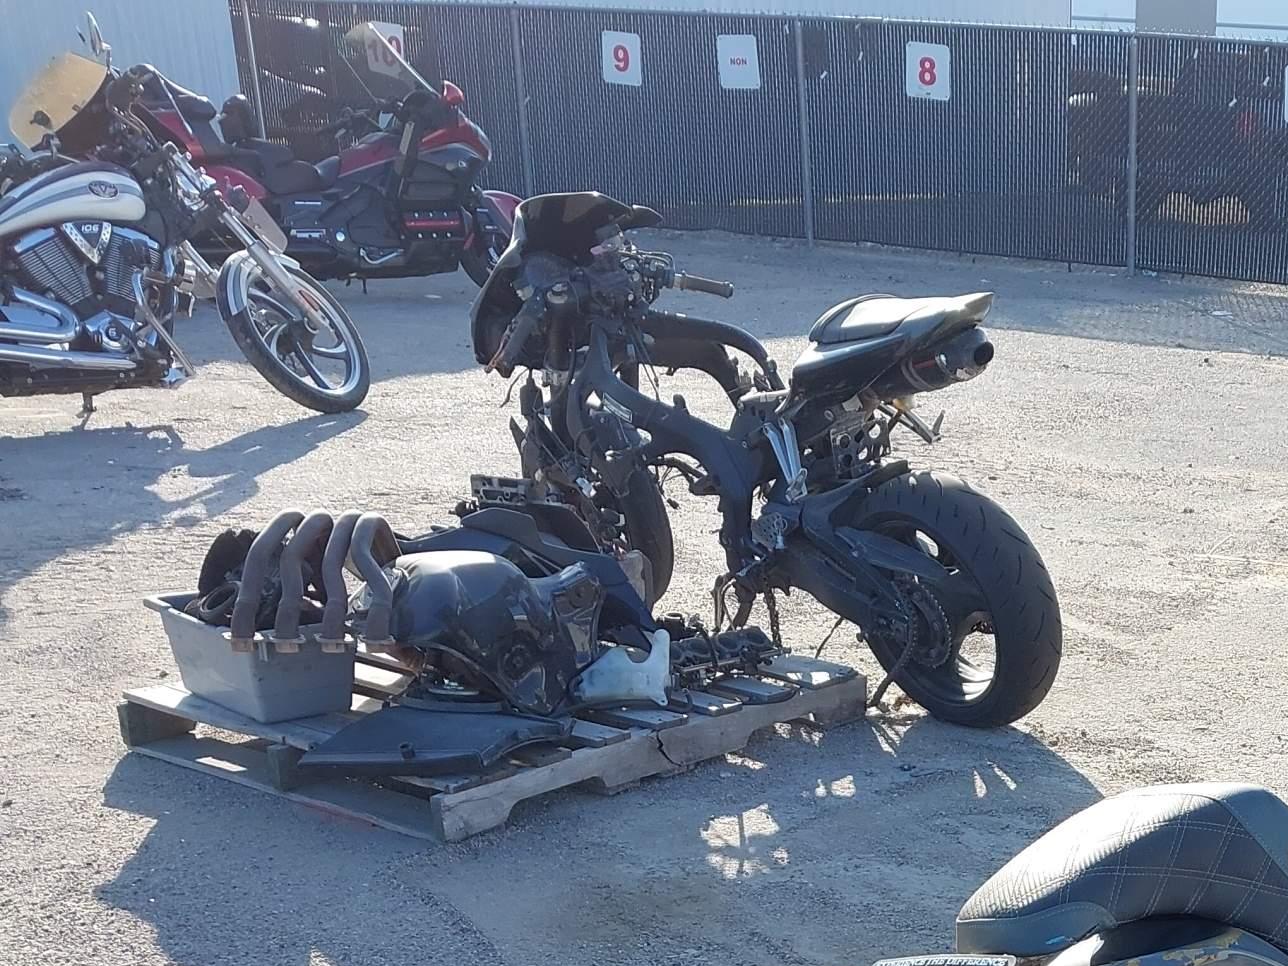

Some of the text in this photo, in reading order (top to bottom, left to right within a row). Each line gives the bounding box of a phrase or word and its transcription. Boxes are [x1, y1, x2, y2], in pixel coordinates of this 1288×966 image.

[613, 44, 630, 73] 9
[729, 57, 748, 66] NON
[918, 56, 937, 86] 8
